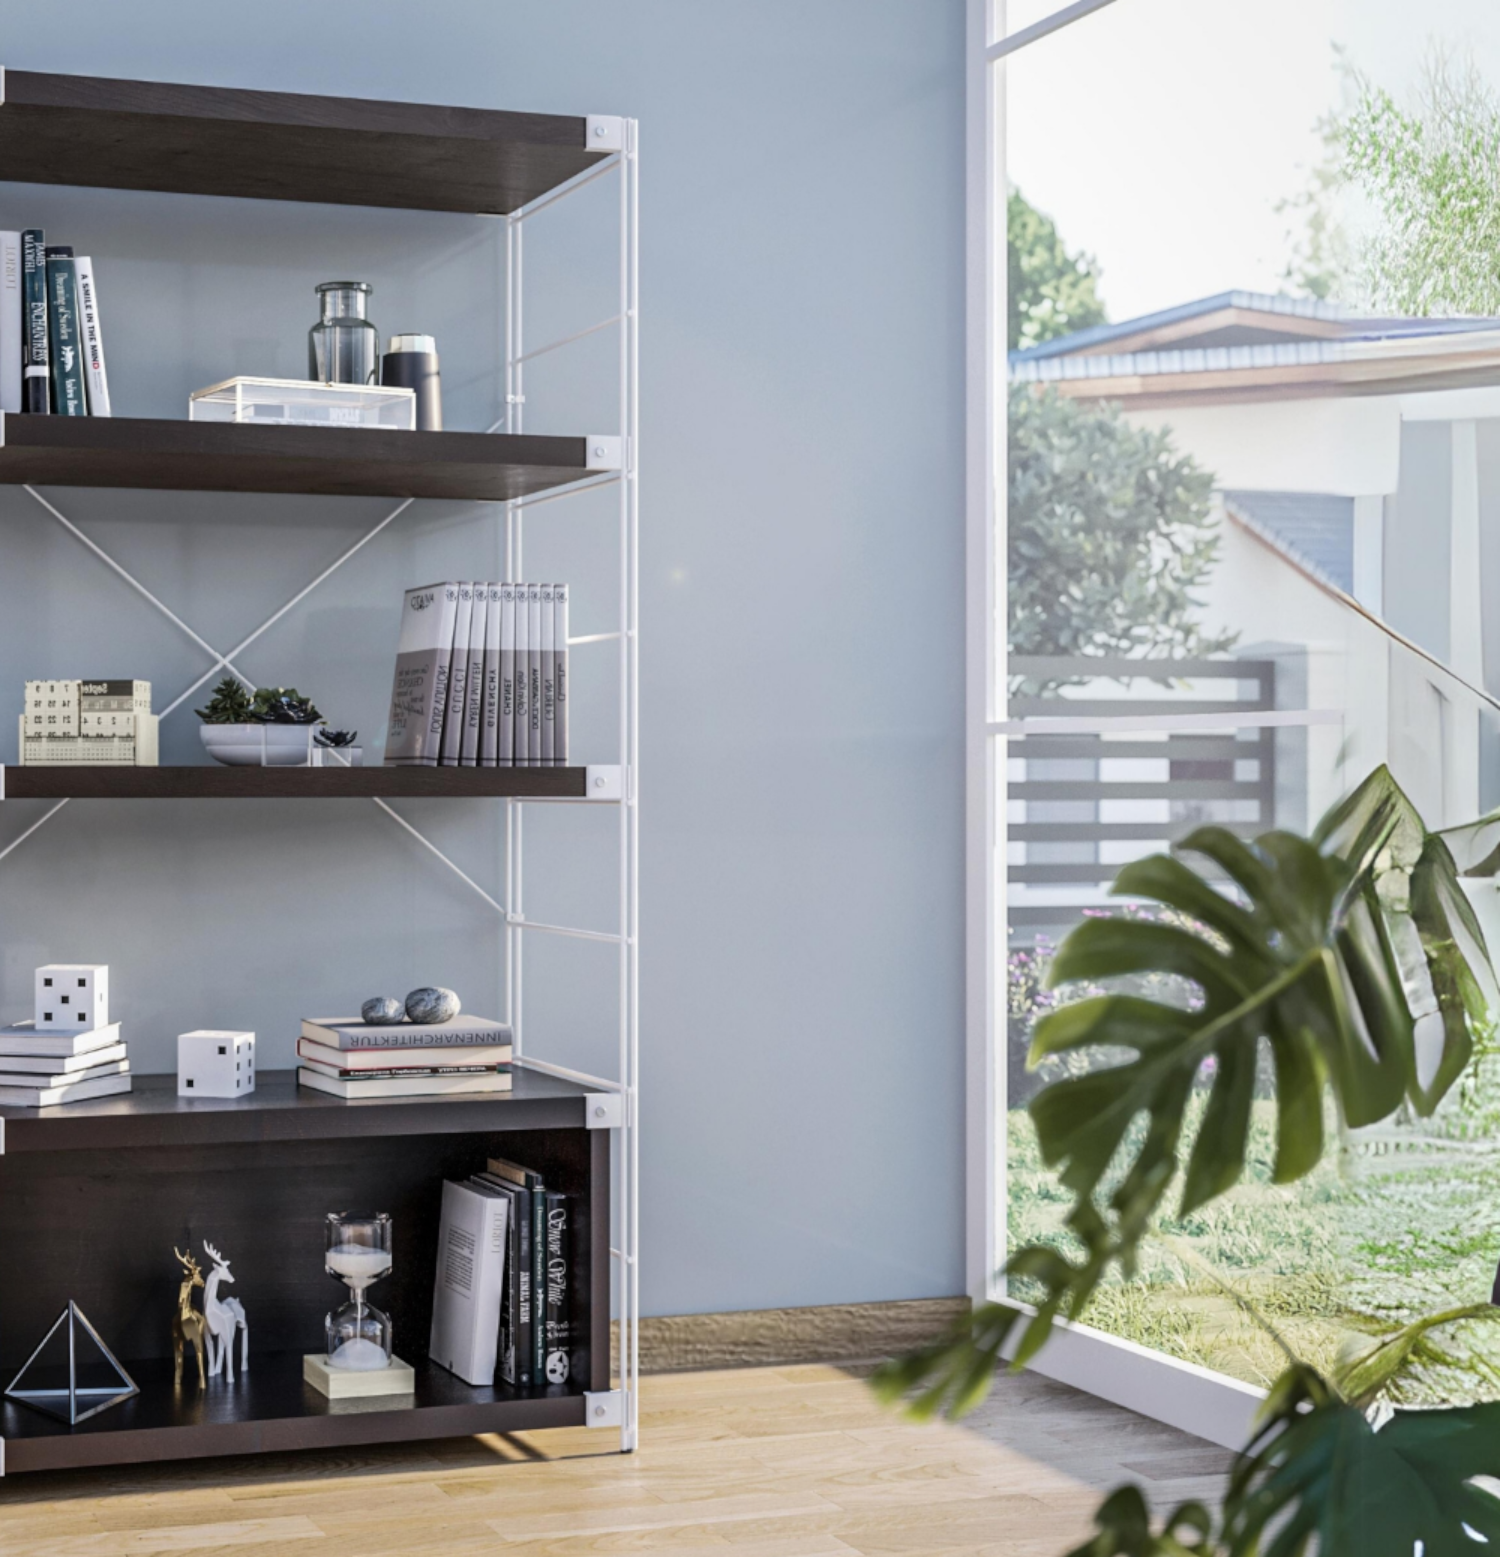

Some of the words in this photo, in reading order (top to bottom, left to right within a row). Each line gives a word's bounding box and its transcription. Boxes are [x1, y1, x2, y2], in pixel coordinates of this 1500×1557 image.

[6, 245, 17, 290] LORIOT
[25, 234, 35, 273] MAXWELL
[35, 242, 45, 266] JAMES
[54, 272, 69, 306] Dreaming
[82, 283, 92, 311] SMILE
[30, 302, 46, 361] ENCHANTRESS
[59, 311, 72, 340] Sweden
[85, 313, 93, 323] IN
[87, 325, 97, 342] THE
[90, 344, 100, 370] MIND
[350, 1031, 501, 1046] INNENARCHITEKTUR
[548, 1208, 567, 1255] Snow
[520, 1271, 530, 1301] ANIMAL
[548, 1258, 567, 1306] White
[520, 1302, 530, 1324] FARM
